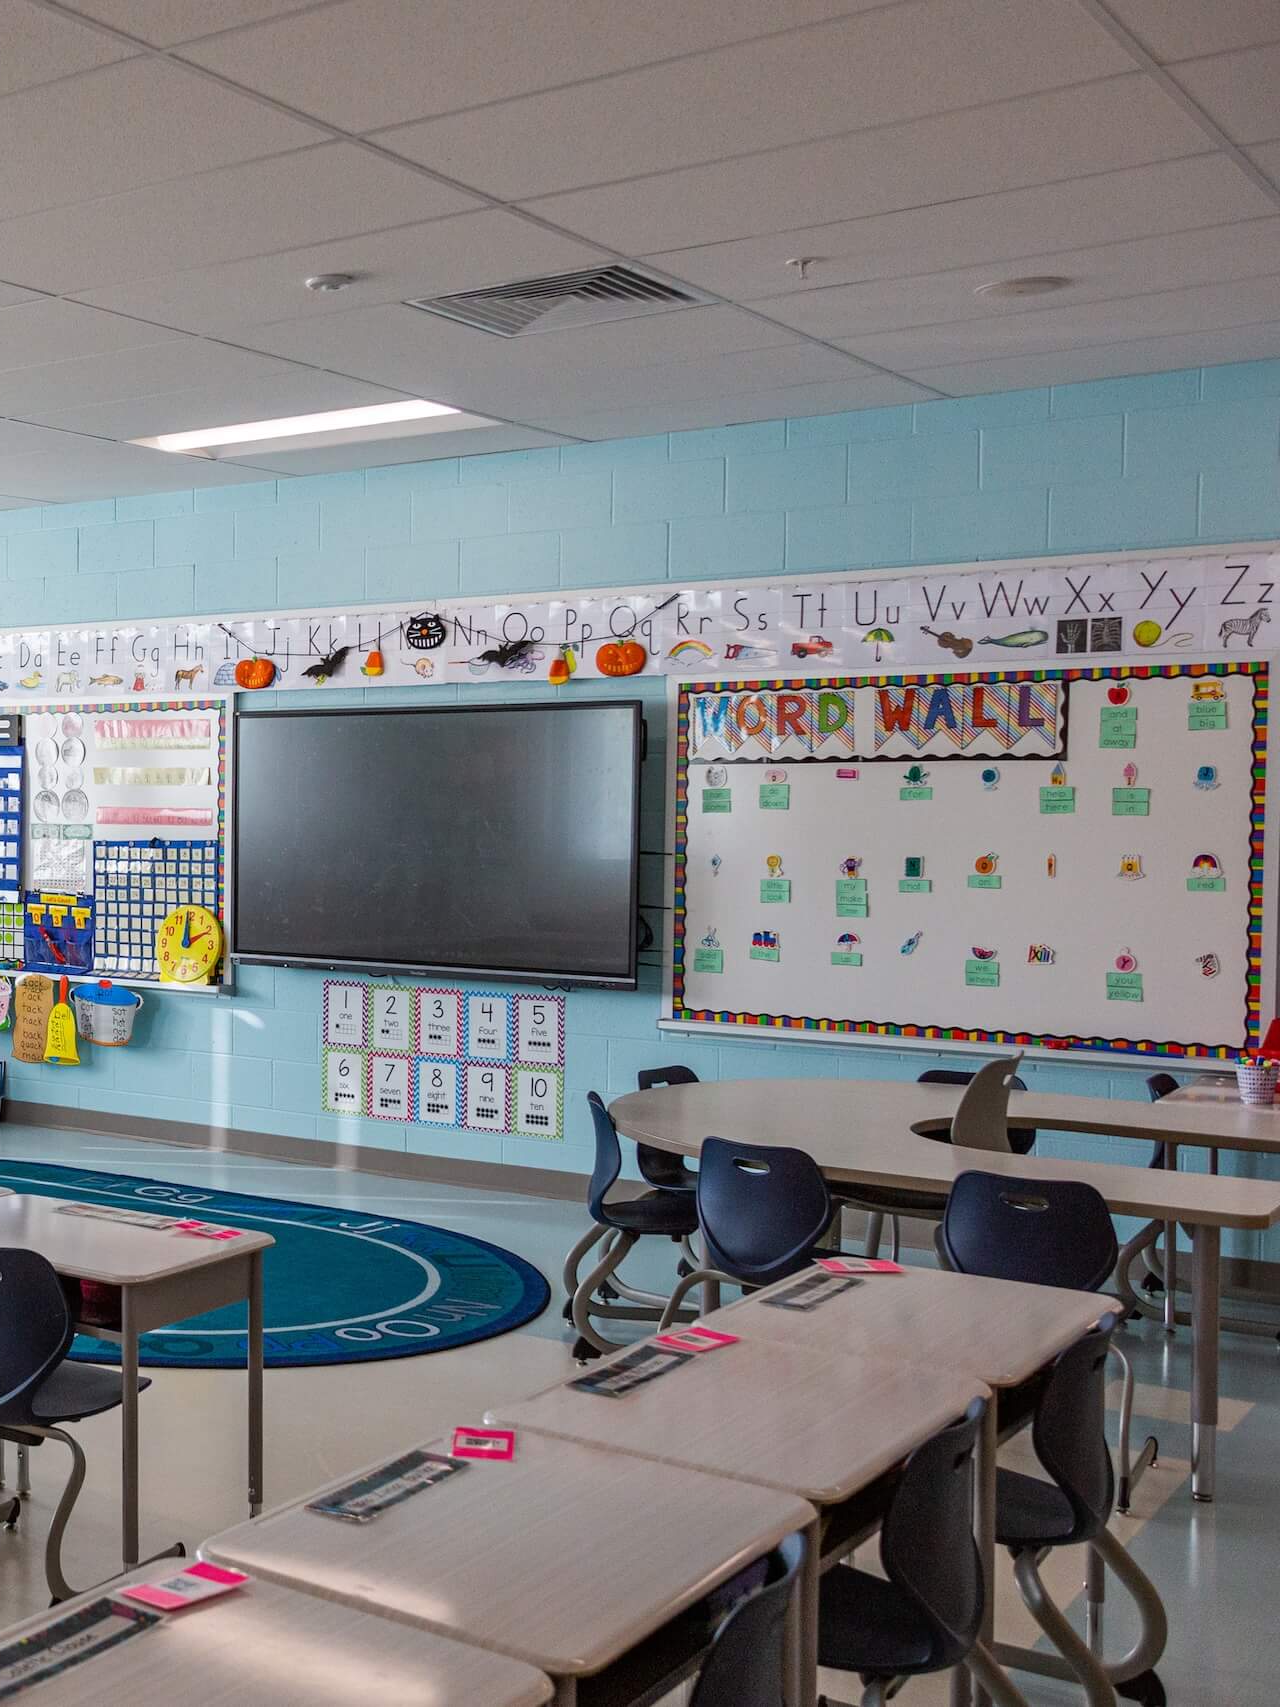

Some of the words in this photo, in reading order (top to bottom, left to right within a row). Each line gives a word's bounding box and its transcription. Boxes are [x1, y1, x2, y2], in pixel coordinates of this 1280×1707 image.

[57, 640, 81, 667] Ee
[95, 636, 118, 665] Ff
[132, 635, 160, 678] Gg
[174, 632, 204, 661] Hh
[308, 623, 337, 656] Kk
[454, 614, 488, 646] Nn
[502, 612, 545, 643] Oo
[565, 608, 593, 659] Pp
[677, 603, 713, 636] Rr
[734, 598, 769, 632] Ss
[792, 593, 828, 629] Tt
[855, 589, 901, 628] Uu
[922, 585, 966, 622] Vv
[978, 580, 1050, 618] Ww
[1065, 575, 1115, 614] Xx
[1140, 570, 1197, 631] Yy
[1221, 565, 1274, 605] Zz
[696, 695, 850, 738] WORD
[877, 686, 1045, 733] WALL
[1196, 704, 1218, 714] blue
[1199, 718, 1216, 730] big
[1103, 737, 1129, 748] away
[34, 913, 40, 922] 0
[54, 915, 60, 925] 3
[175, 915, 183, 925] 11
[165, 926, 175, 936] 10
[161, 938, 168, 948] 9
[208, 940, 214, 950] 3
[163, 951, 170, 961] 8
[202, 954, 209, 964] 4
[192, 963, 198, 973] 5
[344, 990, 349, 1009] 1
[385, 996, 398, 1015] 2
[432, 1000, 445, 1018] 3
[338, 1012, 353, 1020] one
[480, 1002, 493, 1023] 4
[533, 1005, 546, 1025] 5
[383, 1018, 400, 1028] two
[428, 1022, 451, 1034] three
[338, 1058, 350, 1077] 6
[384, 1064, 396, 1082] 7
[431, 1068, 444, 1088] 8
[481, 1072, 494, 1093] 9
[379, 1087, 401, 1096] seven
[530, 1077, 548, 1098] 10
[427, 1090, 448, 1103] eight
[479, 1094, 495, 1104] nine
[530, 1102, 545, 1111] ten
[135, 1186, 214, 1204] Gg
